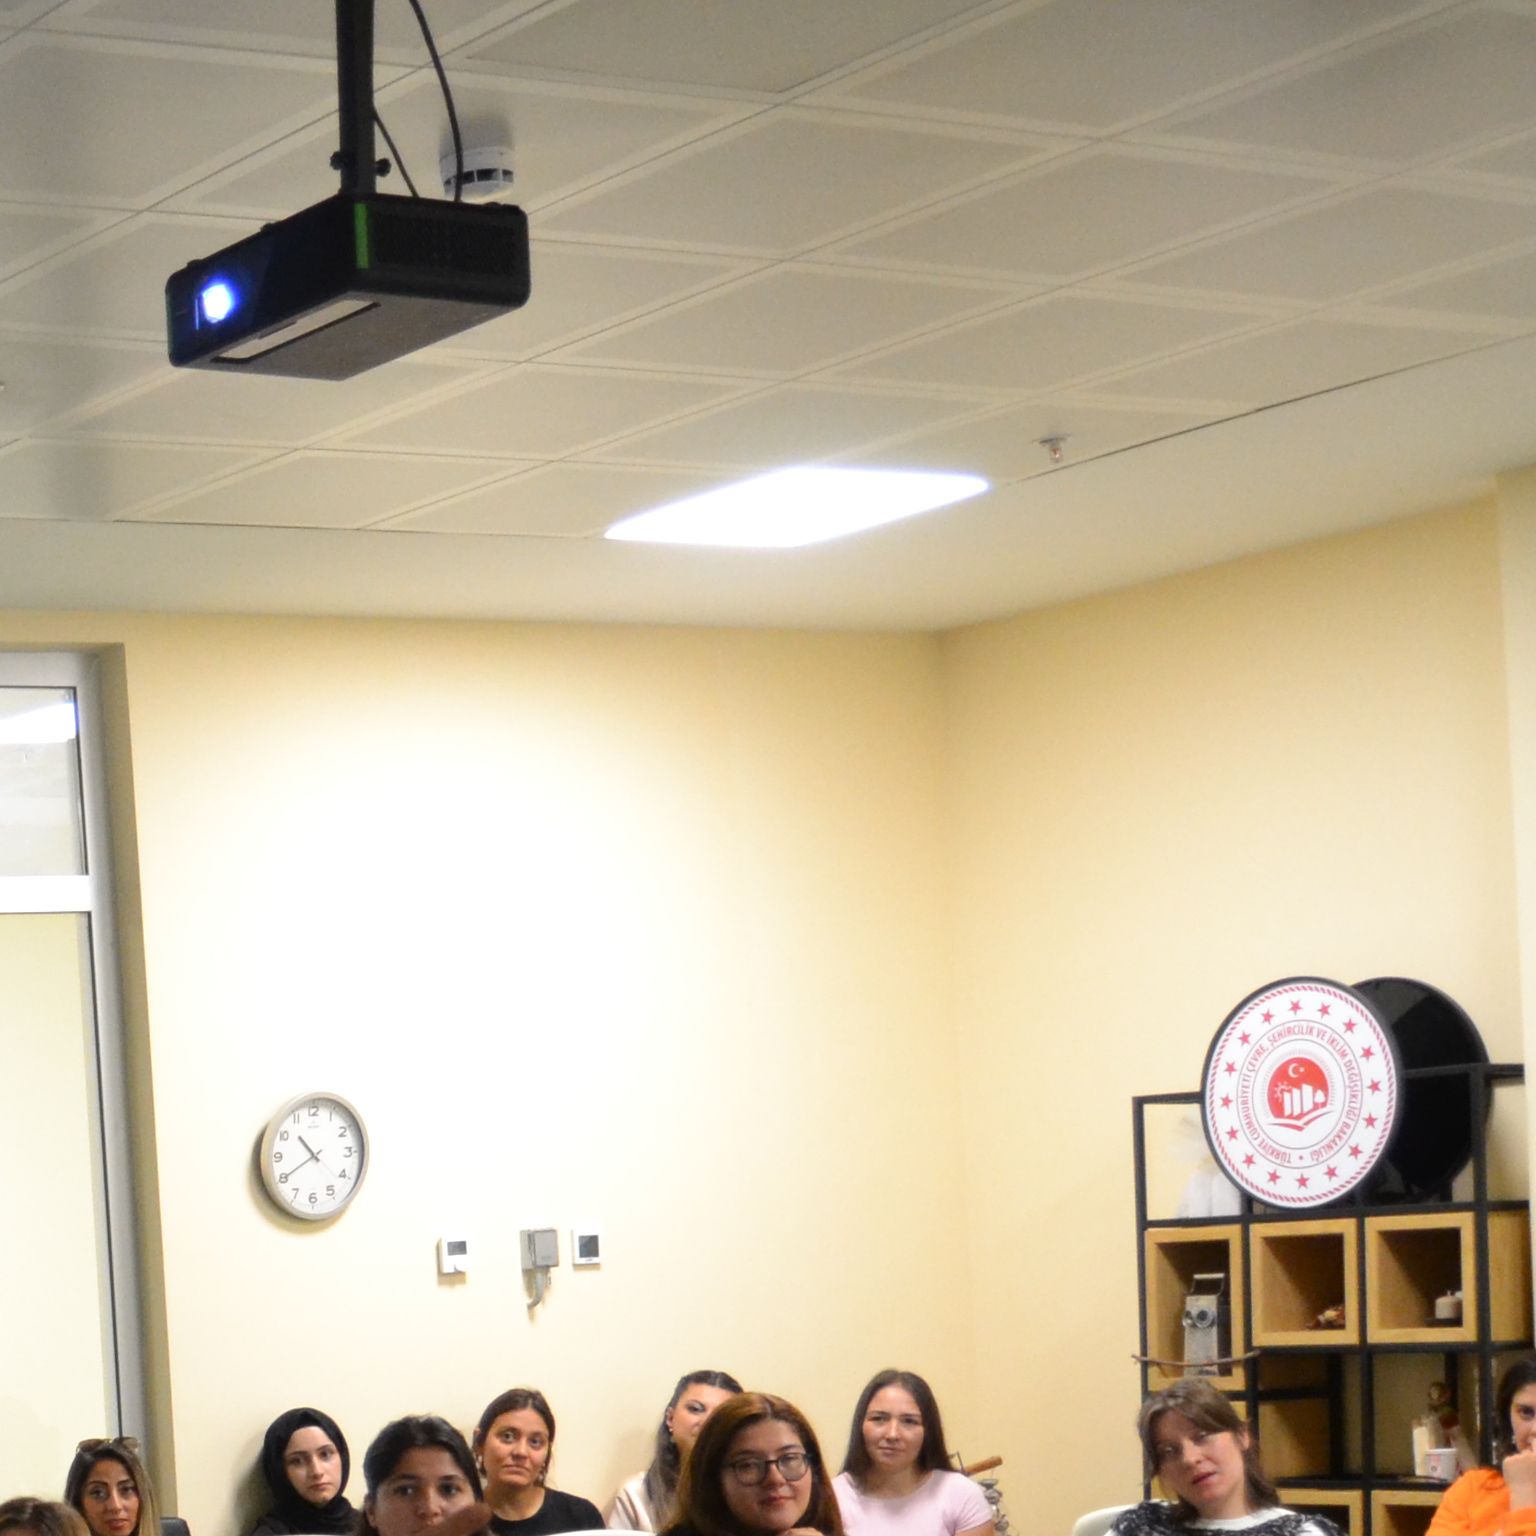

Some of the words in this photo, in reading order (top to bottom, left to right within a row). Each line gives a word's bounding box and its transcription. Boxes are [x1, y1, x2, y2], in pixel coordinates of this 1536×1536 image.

[1268, 1023, 1315, 1046] ŞEHİRCİLİK
[1317, 1028, 1327, 1040] VE
[1327, 1033, 1348, 1060] İKLİM
[308, 1105, 319, 1117] 12
[293, 1113, 300, 1124] 11
[279, 1130, 289, 1142] 10
[338, 1126, 347, 1138] 2
[273, 1152, 283, 1163] 9
[343, 1146, 352, 1158] 3
[278, 1172, 289, 1184] 8
[338, 1168, 347, 1179] 4
[292, 1188, 299, 1199] 7
[326, 1185, 335, 1196] 5
[308, 1192, 318, 1204] 6
